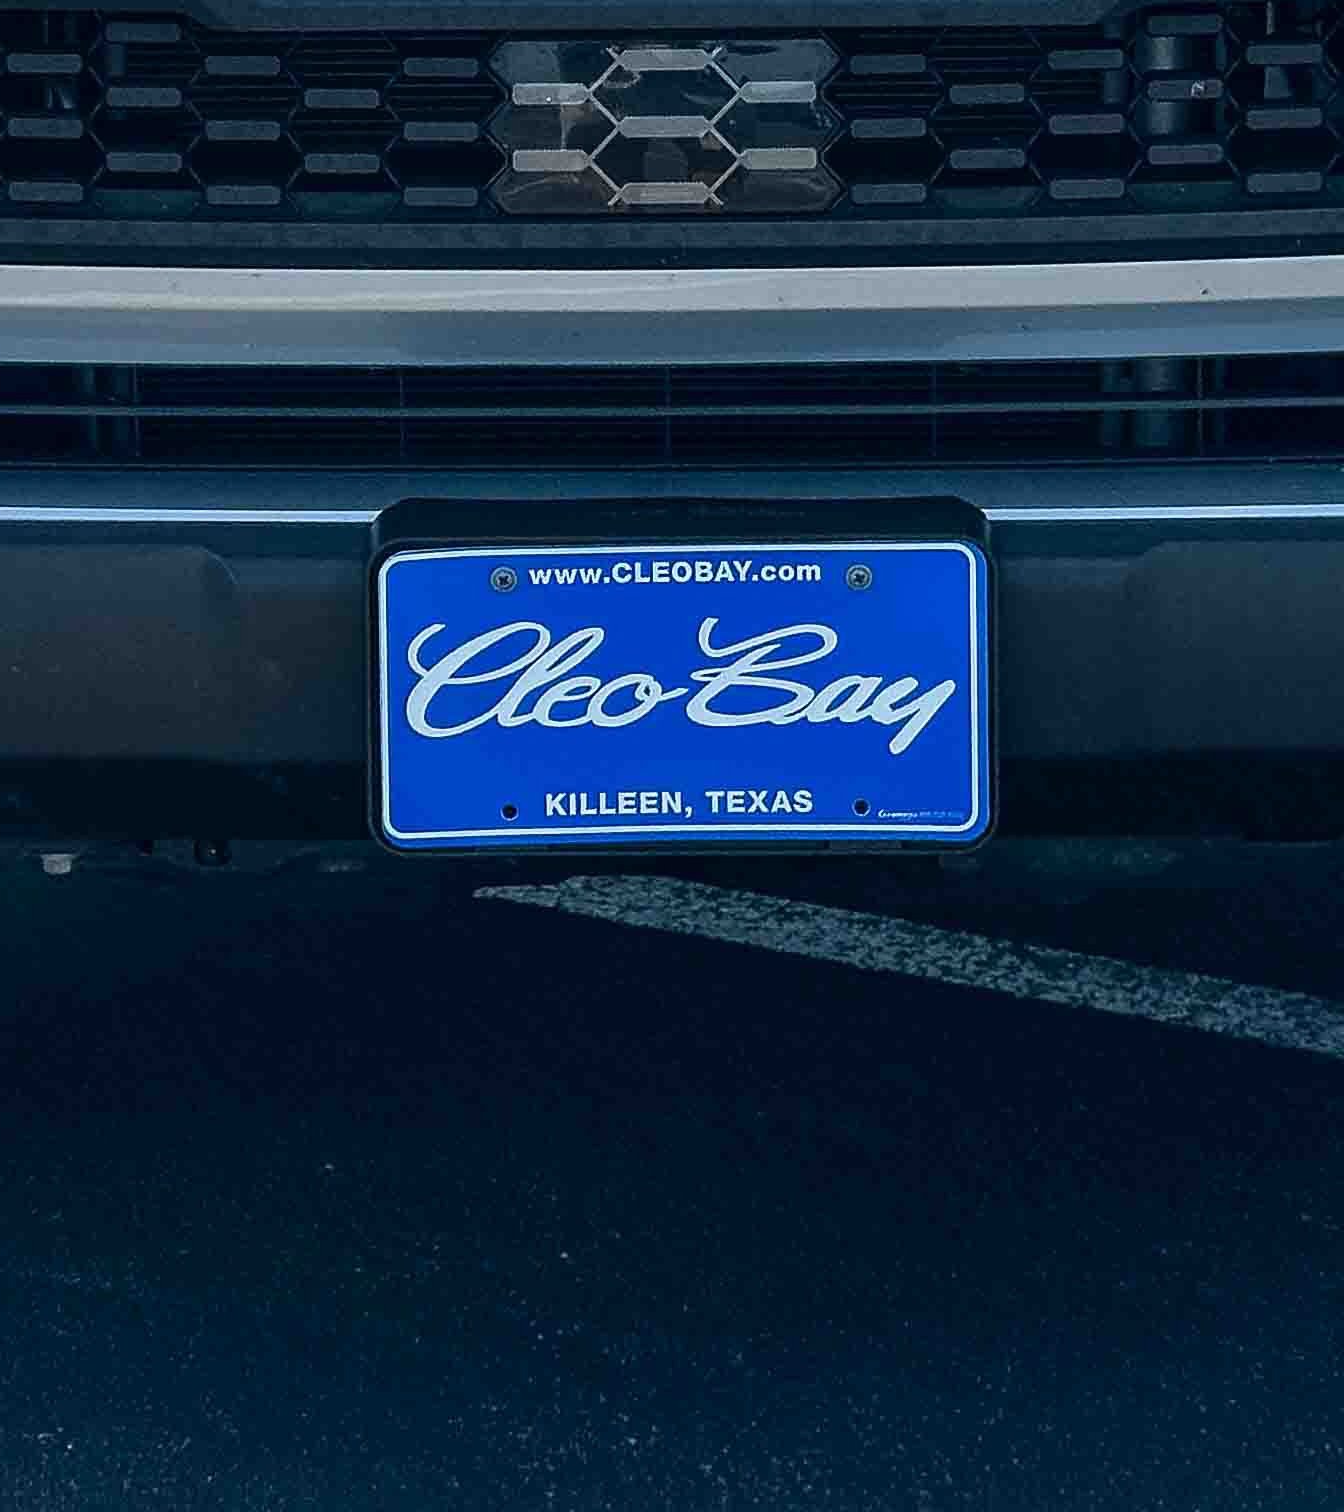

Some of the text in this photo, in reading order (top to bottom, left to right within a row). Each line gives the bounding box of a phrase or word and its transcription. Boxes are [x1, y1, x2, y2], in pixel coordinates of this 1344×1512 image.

[528, 561, 823, 587] www.CLEOBAY.com
[406, 616, 957, 756] Cleo Bay
[544, 789, 814, 820] KILLEEN, TEXAS
